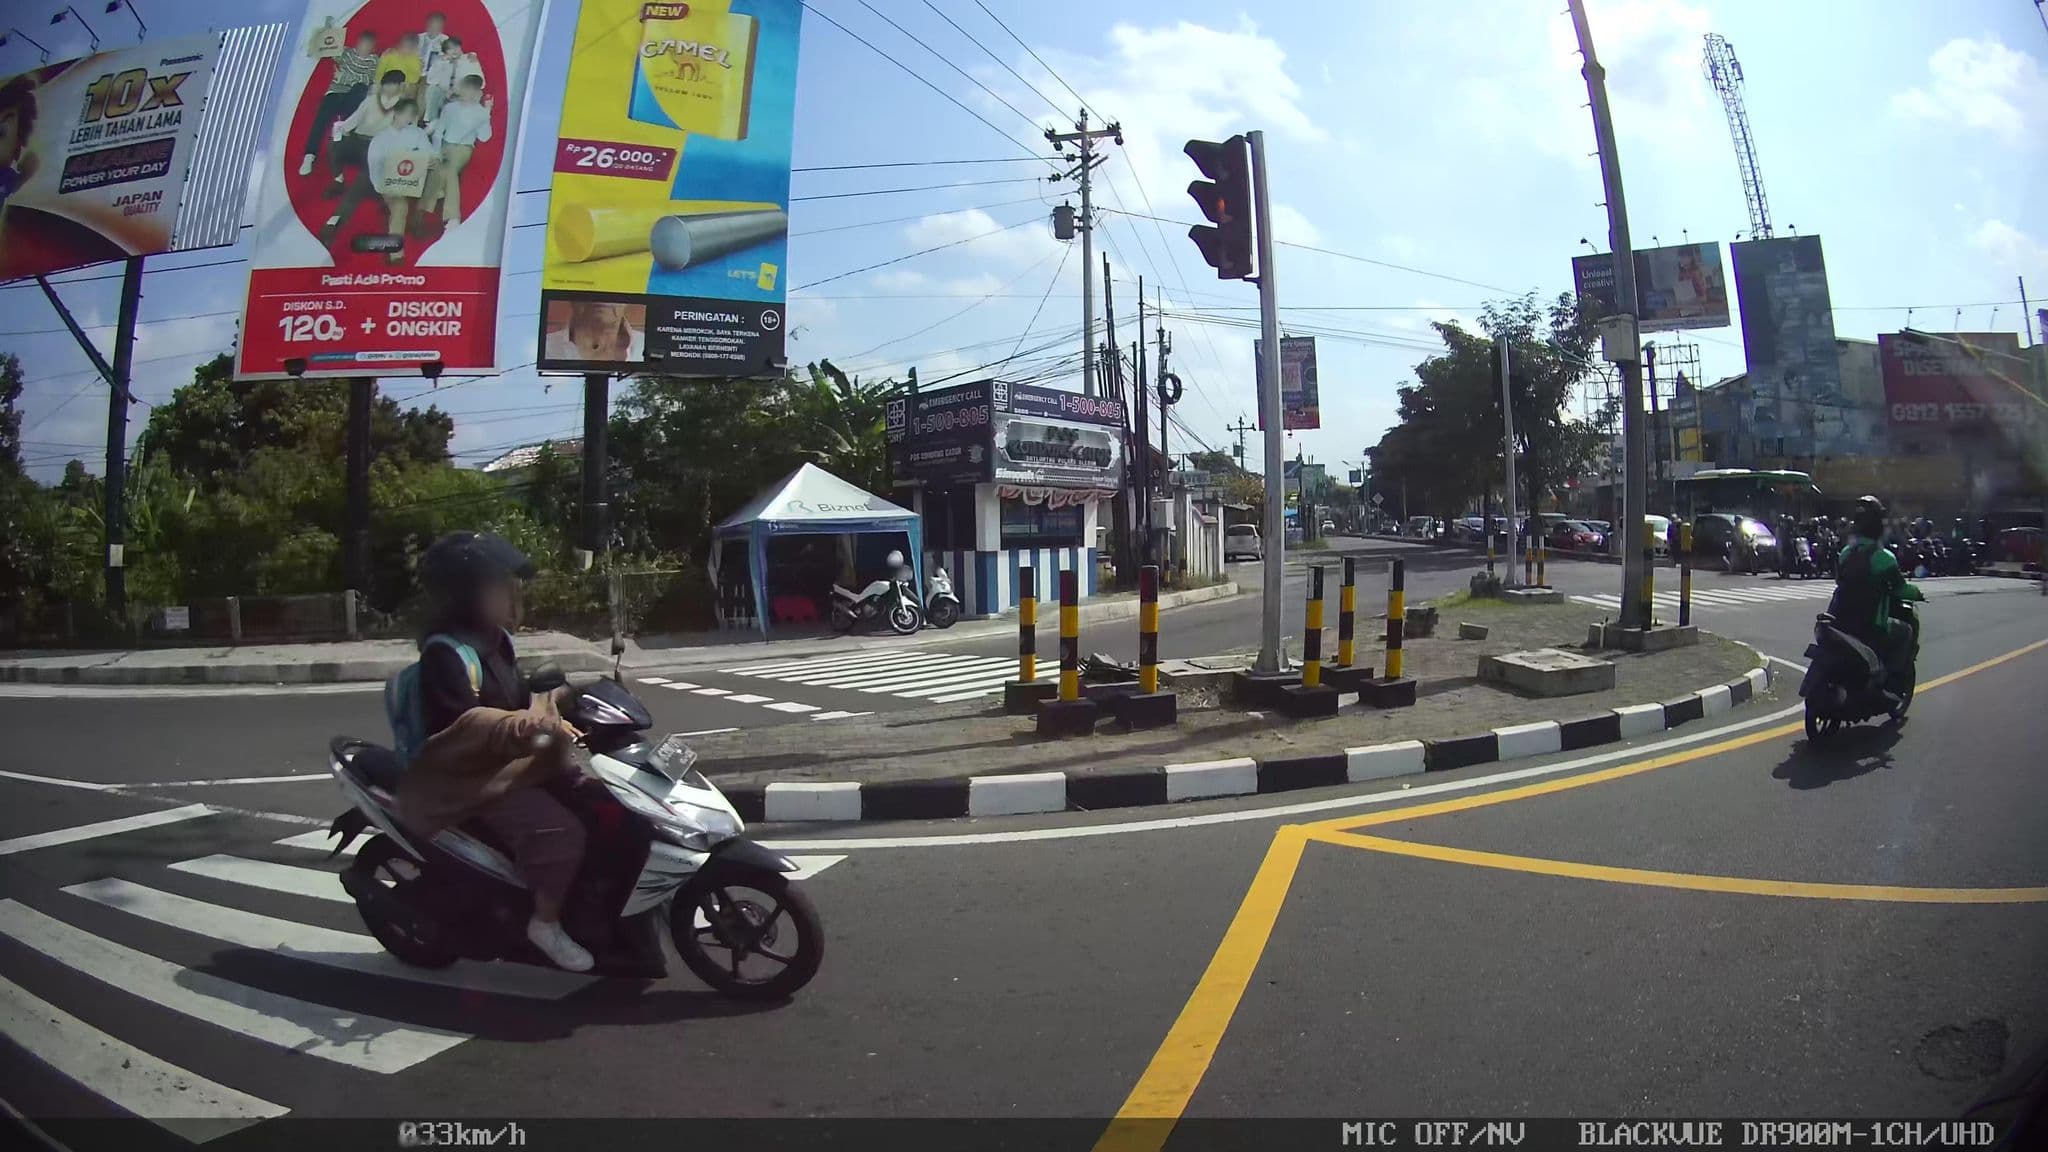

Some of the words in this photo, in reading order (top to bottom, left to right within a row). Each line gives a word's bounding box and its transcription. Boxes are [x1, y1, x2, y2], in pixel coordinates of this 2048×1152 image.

[646, 6, 684, 17] NEW
[639, 39, 732, 69] CAMEL
[69, 124, 104, 144] LEBIH
[104, 117, 146, 138] TAHAN
[146, 110, 182, 130] LAMA
[565, 144, 581, 154] Rp
[62, 171, 106, 189] POWER
[107, 166, 140, 180] YOUR
[141, 161, 168, 174] DAY
[112, 190, 164, 207] JAPAN
[123, 201, 161, 217] QUALITY
[322, 274, 352, 285] Pasti
[354, 274, 379, 285] Ada
[381, 274, 425, 285] Promo
[283, 301, 323, 312] DISKON
[325, 301, 347, 311] S.D.
[388, 301, 462, 318] DISKON
[674, 310, 739, 323] PERINGATAN
[386, 320, 461, 337] ONGKIR
[929, 393, 965, 407] EMERGENCY
[965, 389, 982, 400] CALL
[1059, 393, 1121, 419] 1-500-805
[913, 404, 989, 435] 1-500-805
[818, 502, 873, 512] Biznet
